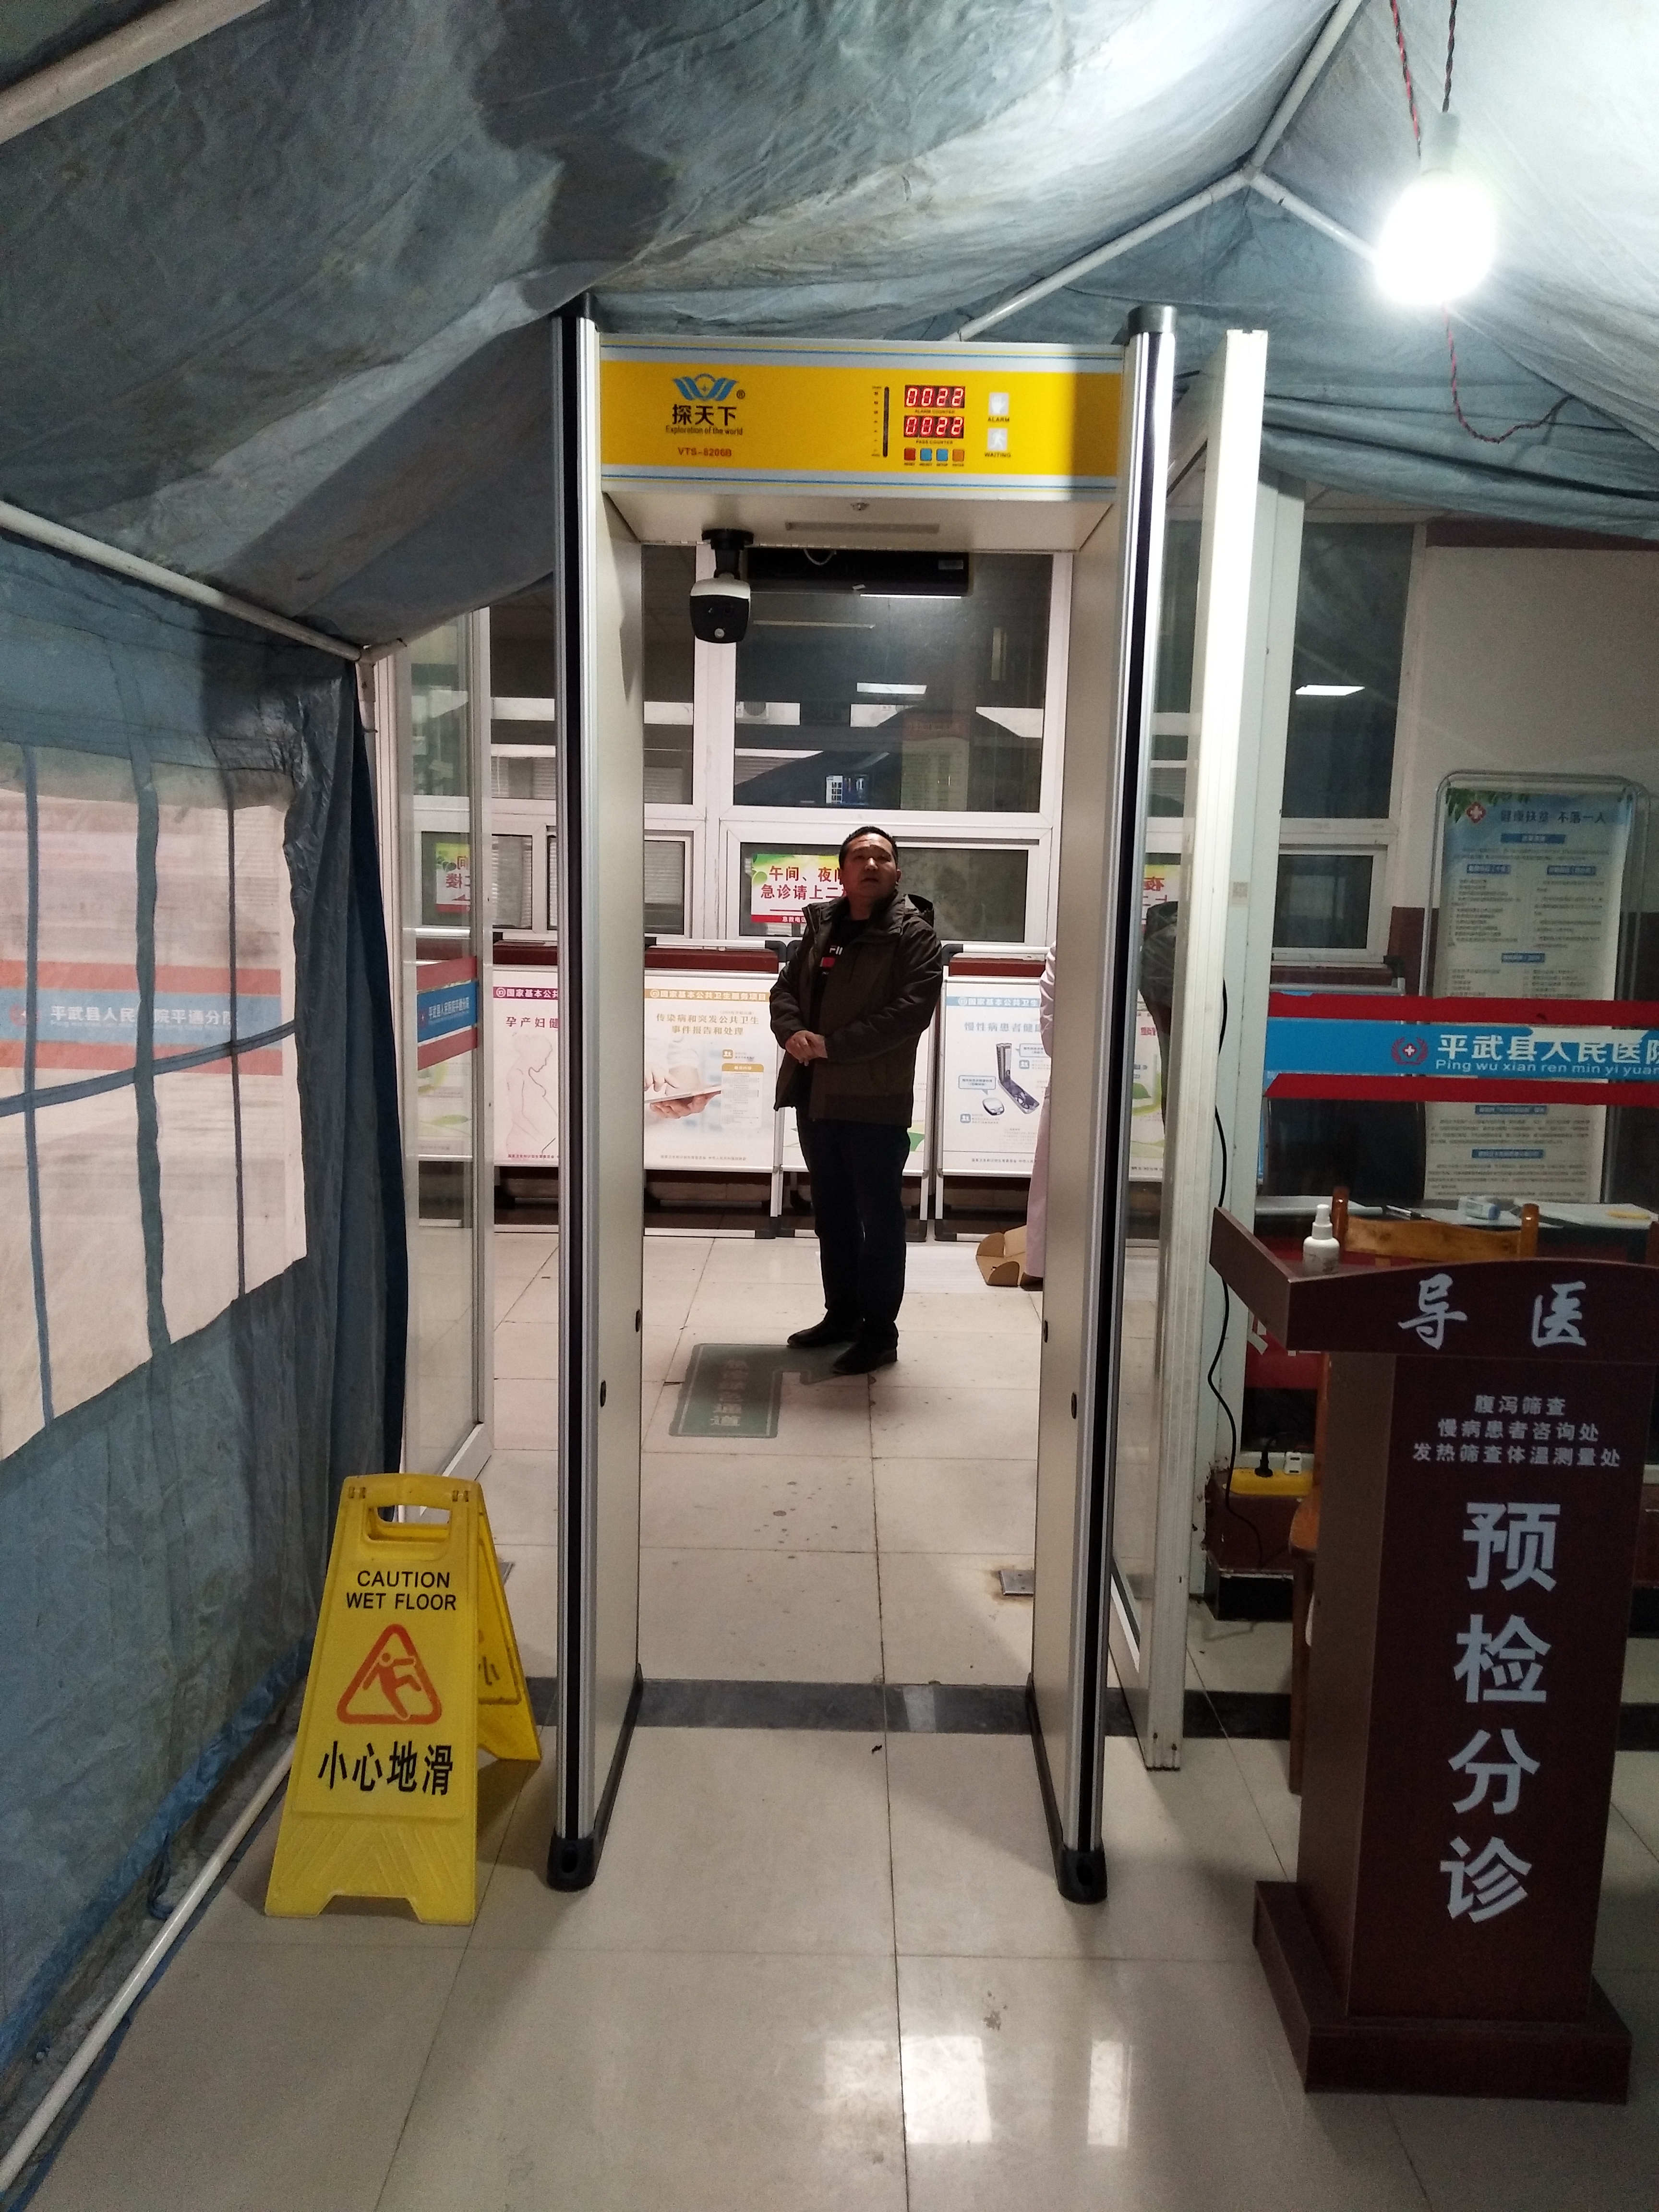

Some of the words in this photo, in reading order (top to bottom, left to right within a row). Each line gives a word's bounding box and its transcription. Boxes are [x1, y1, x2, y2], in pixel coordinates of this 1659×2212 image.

[906, 387, 964, 407] 0022
[672, 404, 737, 426] 探天下
[666, 425, 703, 435] Exploration
[725, 427, 743, 435] world
[905, 417, 963, 436] 0022
[761, 884, 844, 900] 急诊请上二
[660, 990, 767, 1001] 国家基本公共卫生服务项目
[968, 998, 1039, 1006] 国家基本公共卫生
[657, 1013, 759, 1025] 传染病和突发公共卫生
[672, 1025, 744, 1035] 事件报告和处理
[1436, 1059, 1471, 1072] Ping
[1476, 1062, 1498, 1070] wu
[1503, 1062, 1536, 1071] xian
[1541, 1064, 1567, 1073] ren
[1571, 1064, 1601, 1074] min
[1605, 1064, 1619, 1076] yi
[1398, 1273, 1587, 1350] 导医
[1475, 1395, 1566, 1416] 腹泻筛查
[1438, 1418, 1599, 1442] 慢病患者咨询处
[1413, 1443, 1621, 1467] 发热筛查体温测量处
[357, 1570, 450, 1588] CAUTION
[347, 1593, 386, 1609] WET
[394, 1593, 456, 1611] FLOOR
[1440, 1502, 1561, 1923] 预检分诊
[318, 1741, 453, 1795] 小心地滑
